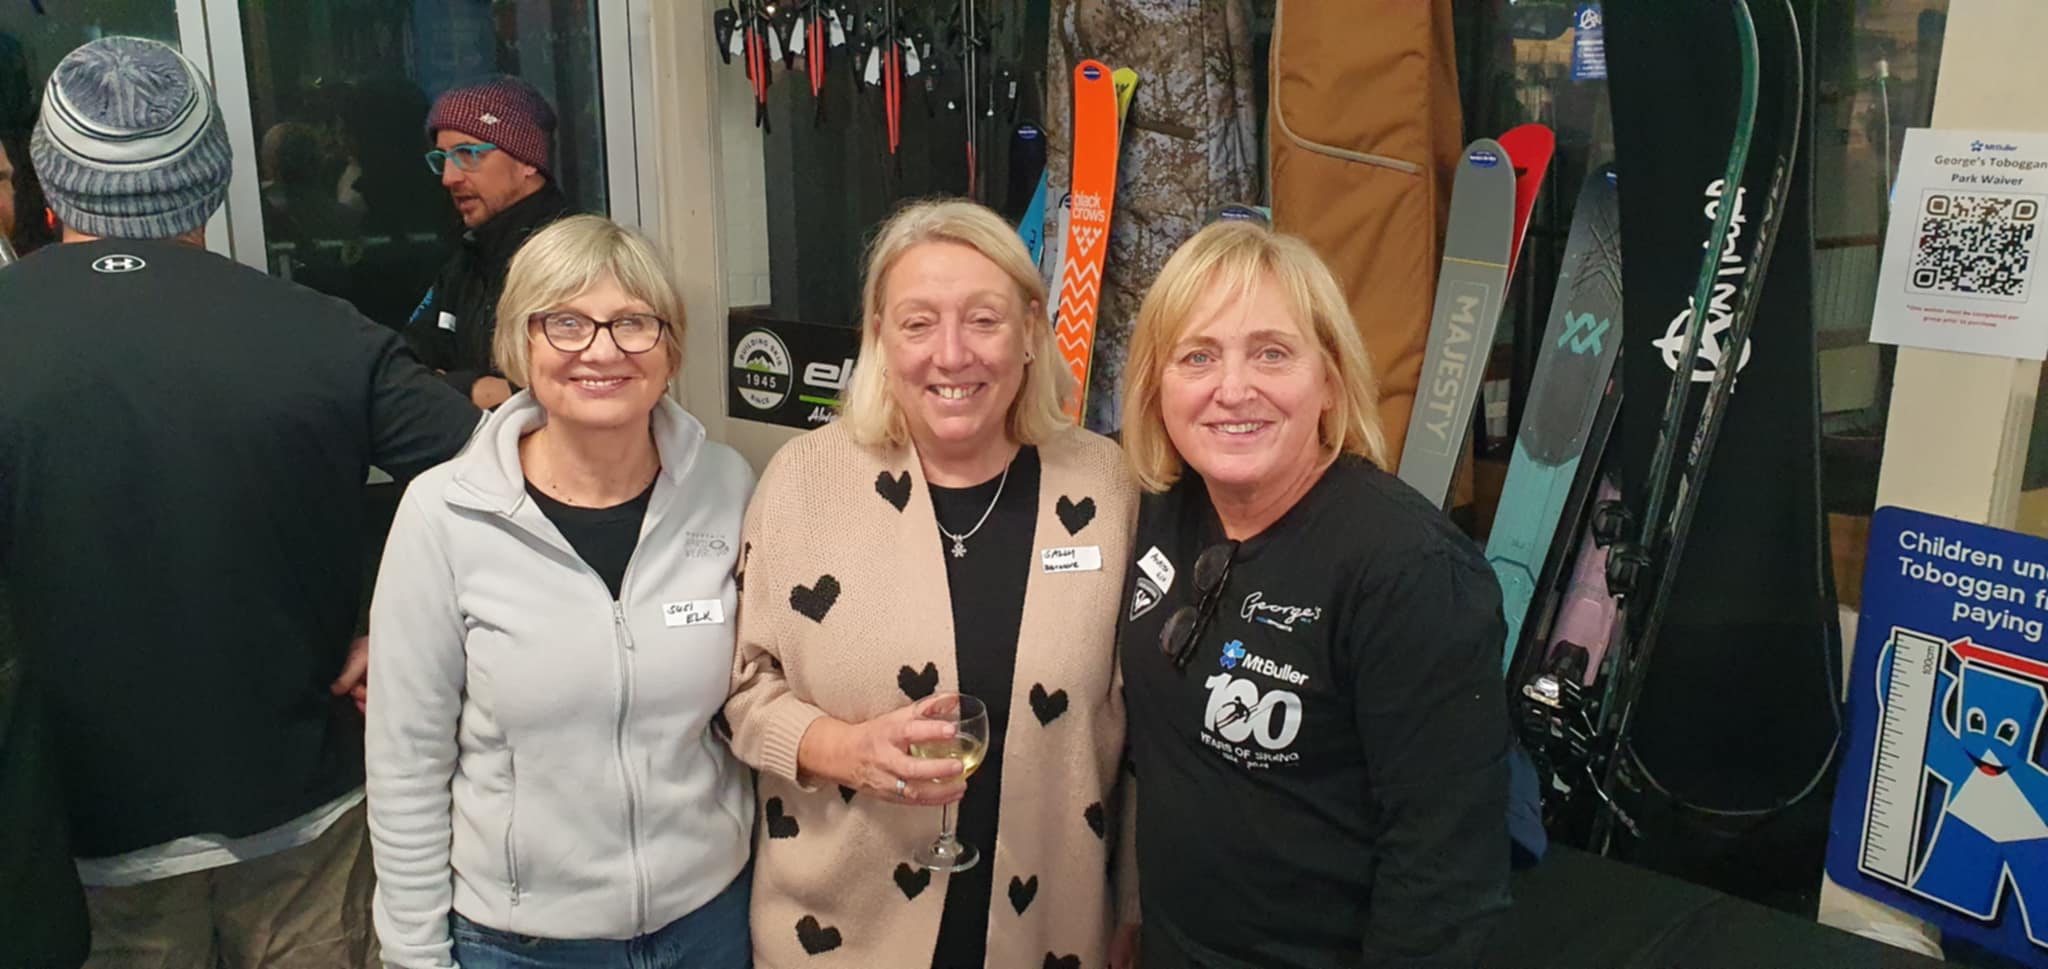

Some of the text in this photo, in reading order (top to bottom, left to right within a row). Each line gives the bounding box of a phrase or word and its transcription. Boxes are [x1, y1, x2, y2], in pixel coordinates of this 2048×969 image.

[1934, 155, 2048, 171] George's Toboggan
[1951, 173, 2024, 186] Park Waiver
[1071, 208, 1105, 223] crows
[1073, 189, 1101, 209] black
[745, 373, 777, 389] 1945
[803, 357, 853, 390] el
[1425, 294, 1481, 441] MAJESTY
[1898, 530, 2048, 582] Children un
[1898, 556, 2026, 605] Toboggan
[1240, 591, 1322, 624] George's
[1952, 601, 2044, 642] paying
[1241, 653, 1310, 686] MtBuller
[1922, 645, 1936, 676] 100cm
[1204, 672, 1304, 750] 100
[1200, 731, 1233, 754] YEARS
[1234, 747, 1251, 760] OF
